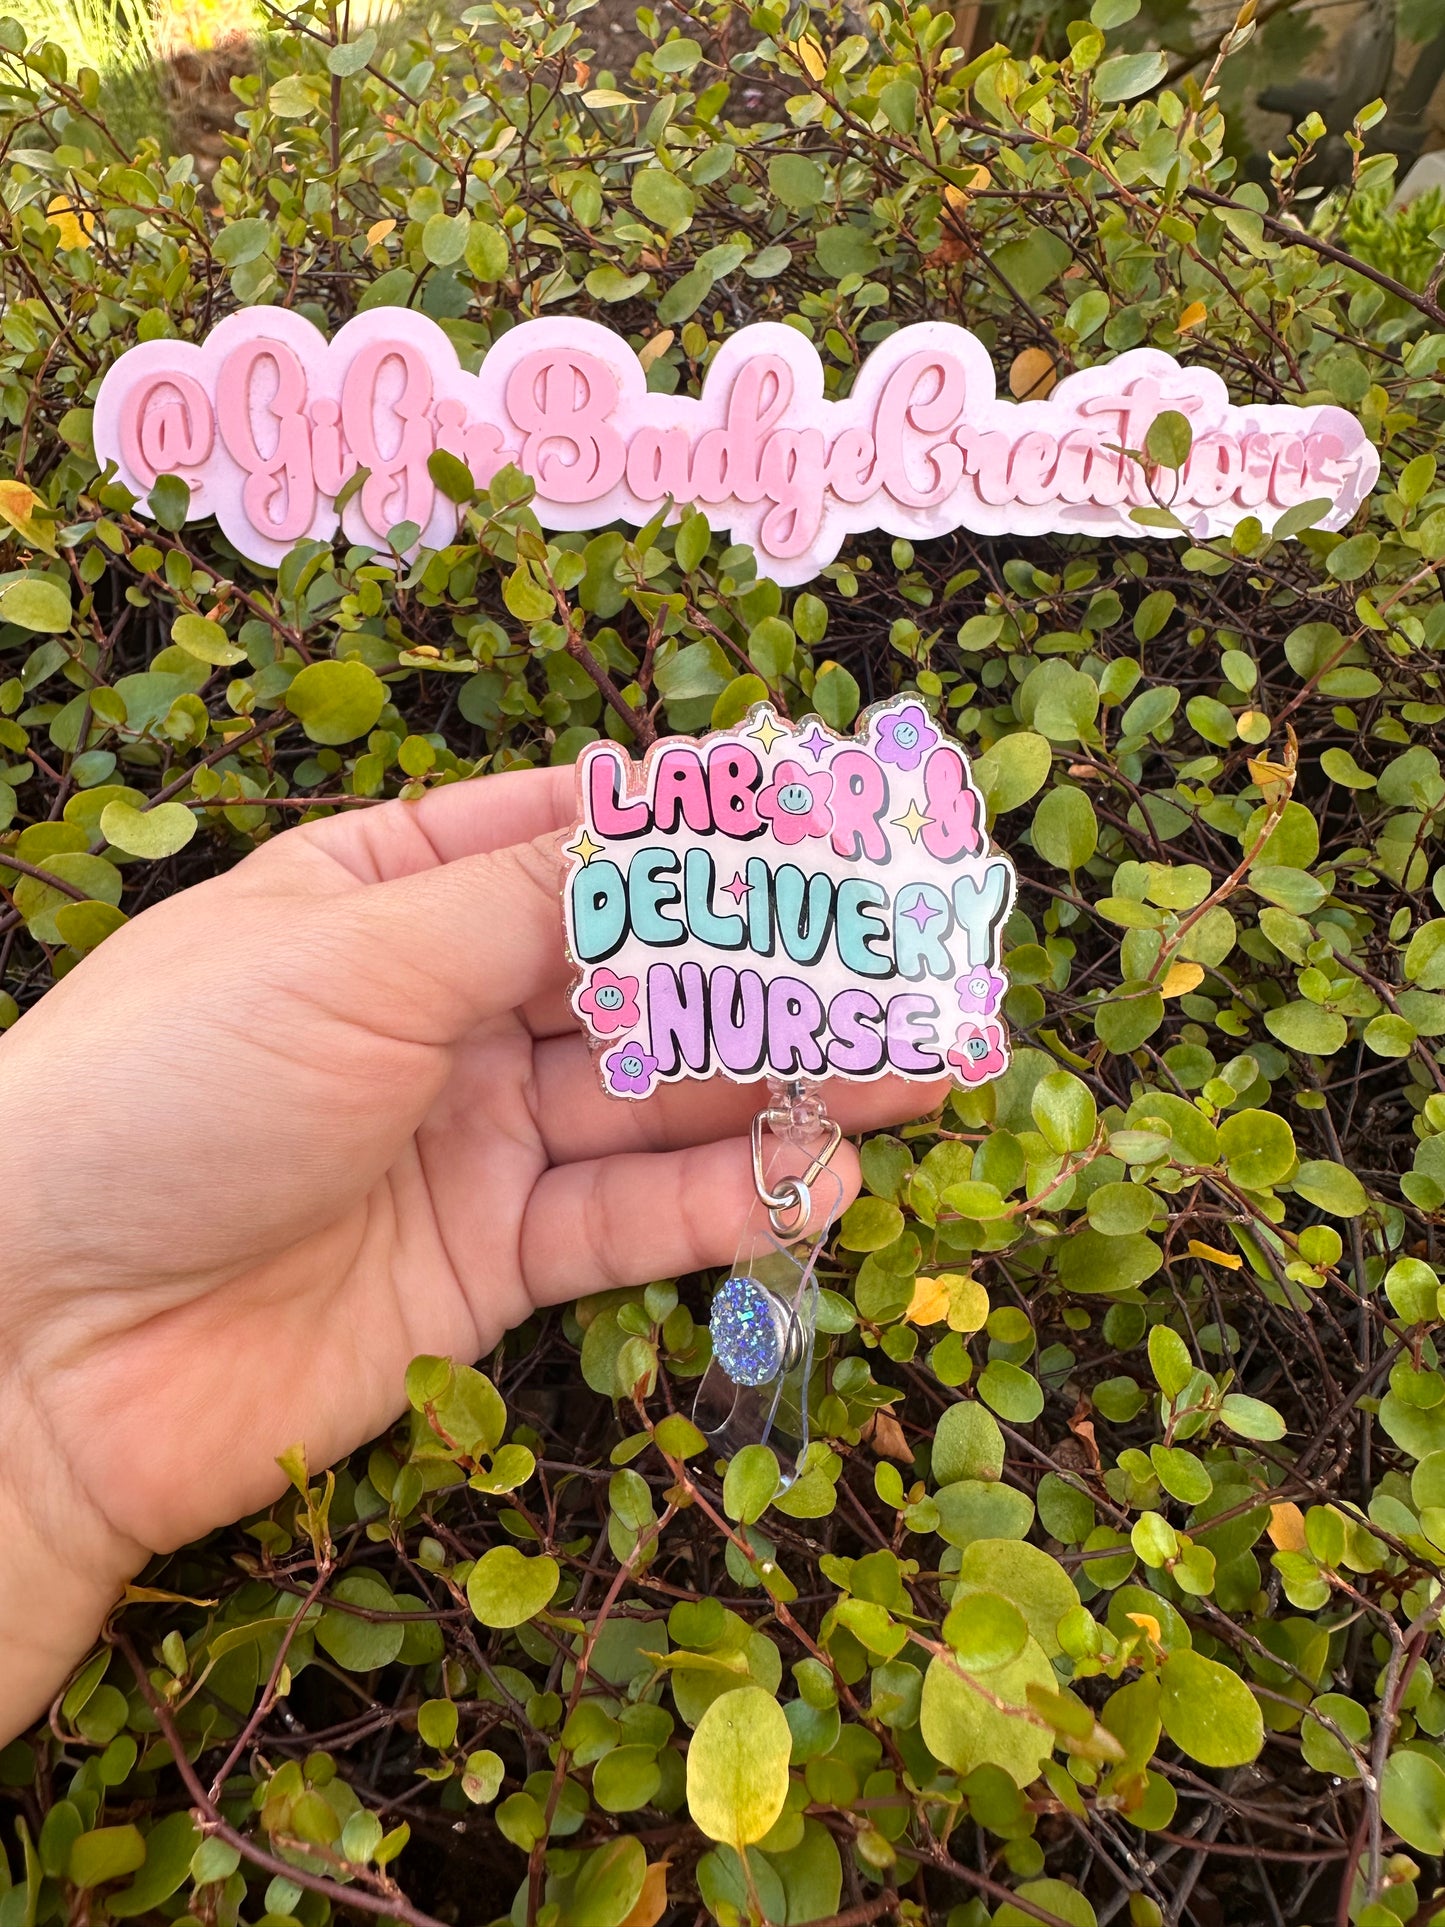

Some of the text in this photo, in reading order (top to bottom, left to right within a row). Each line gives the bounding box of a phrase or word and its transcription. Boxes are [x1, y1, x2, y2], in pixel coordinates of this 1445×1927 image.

[919, 747, 985, 860] &
[572, 847, 1009, 982] DELIVERY
[646, 962, 946, 1076] NURSE
